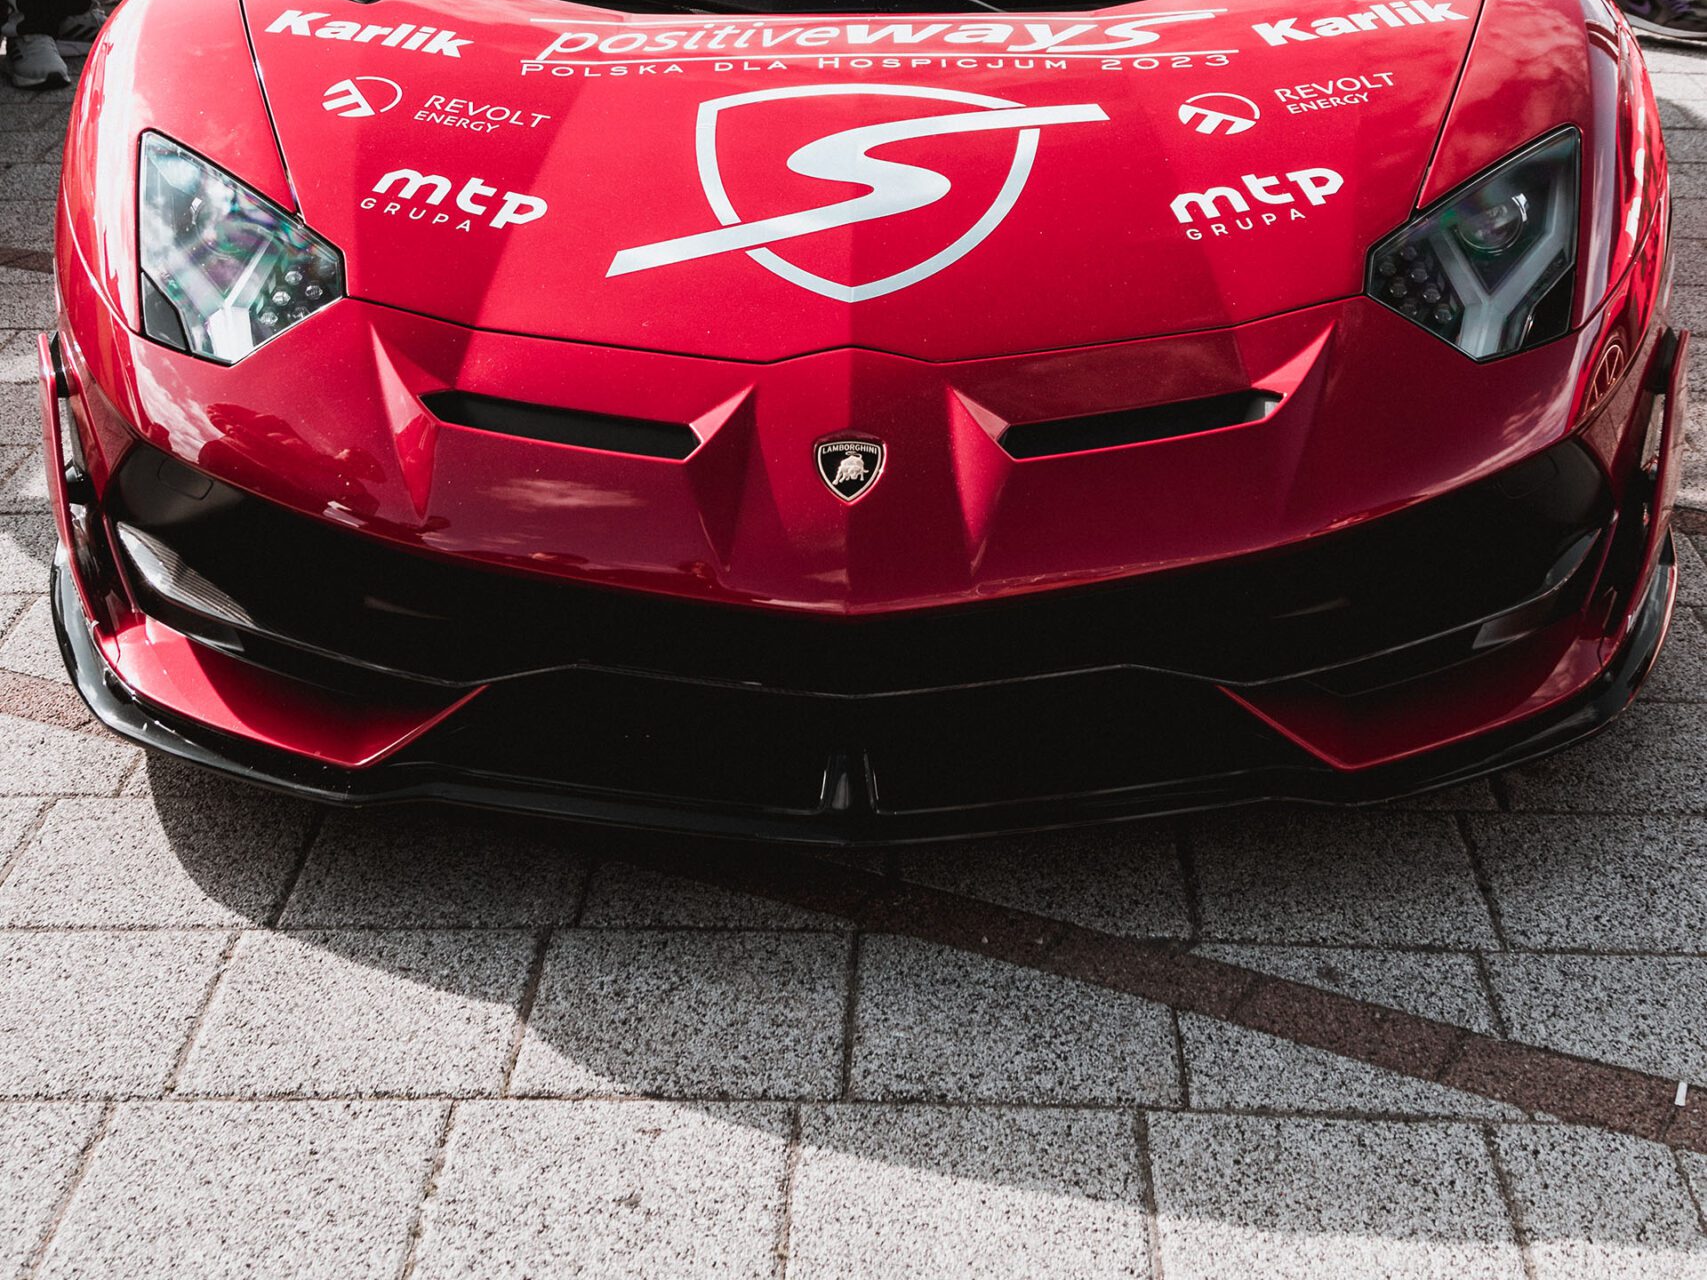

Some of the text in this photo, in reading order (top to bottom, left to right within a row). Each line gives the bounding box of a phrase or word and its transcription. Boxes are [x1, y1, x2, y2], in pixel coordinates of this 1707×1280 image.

[264, 9, 475, 58] Karlik
[1251, 0, 1470, 46] Karlik
[521, 54, 1230, 77] POLSKA DLA HOSPICJUM 2023
[1274, 72, 1395, 102] REVOLT
[1286, 91, 1369, 114] ENERGY
[413, 111, 500, 133] ENERGY
[424, 95, 551, 128] REVOLT
[371, 168, 548, 229] mtp
[1169, 167, 1345, 224] mtp
[360, 197, 472, 232] GRUPA
[1185, 208, 1306, 240] GRUPA
[822, 443, 878, 456] LAMBORGHINI
